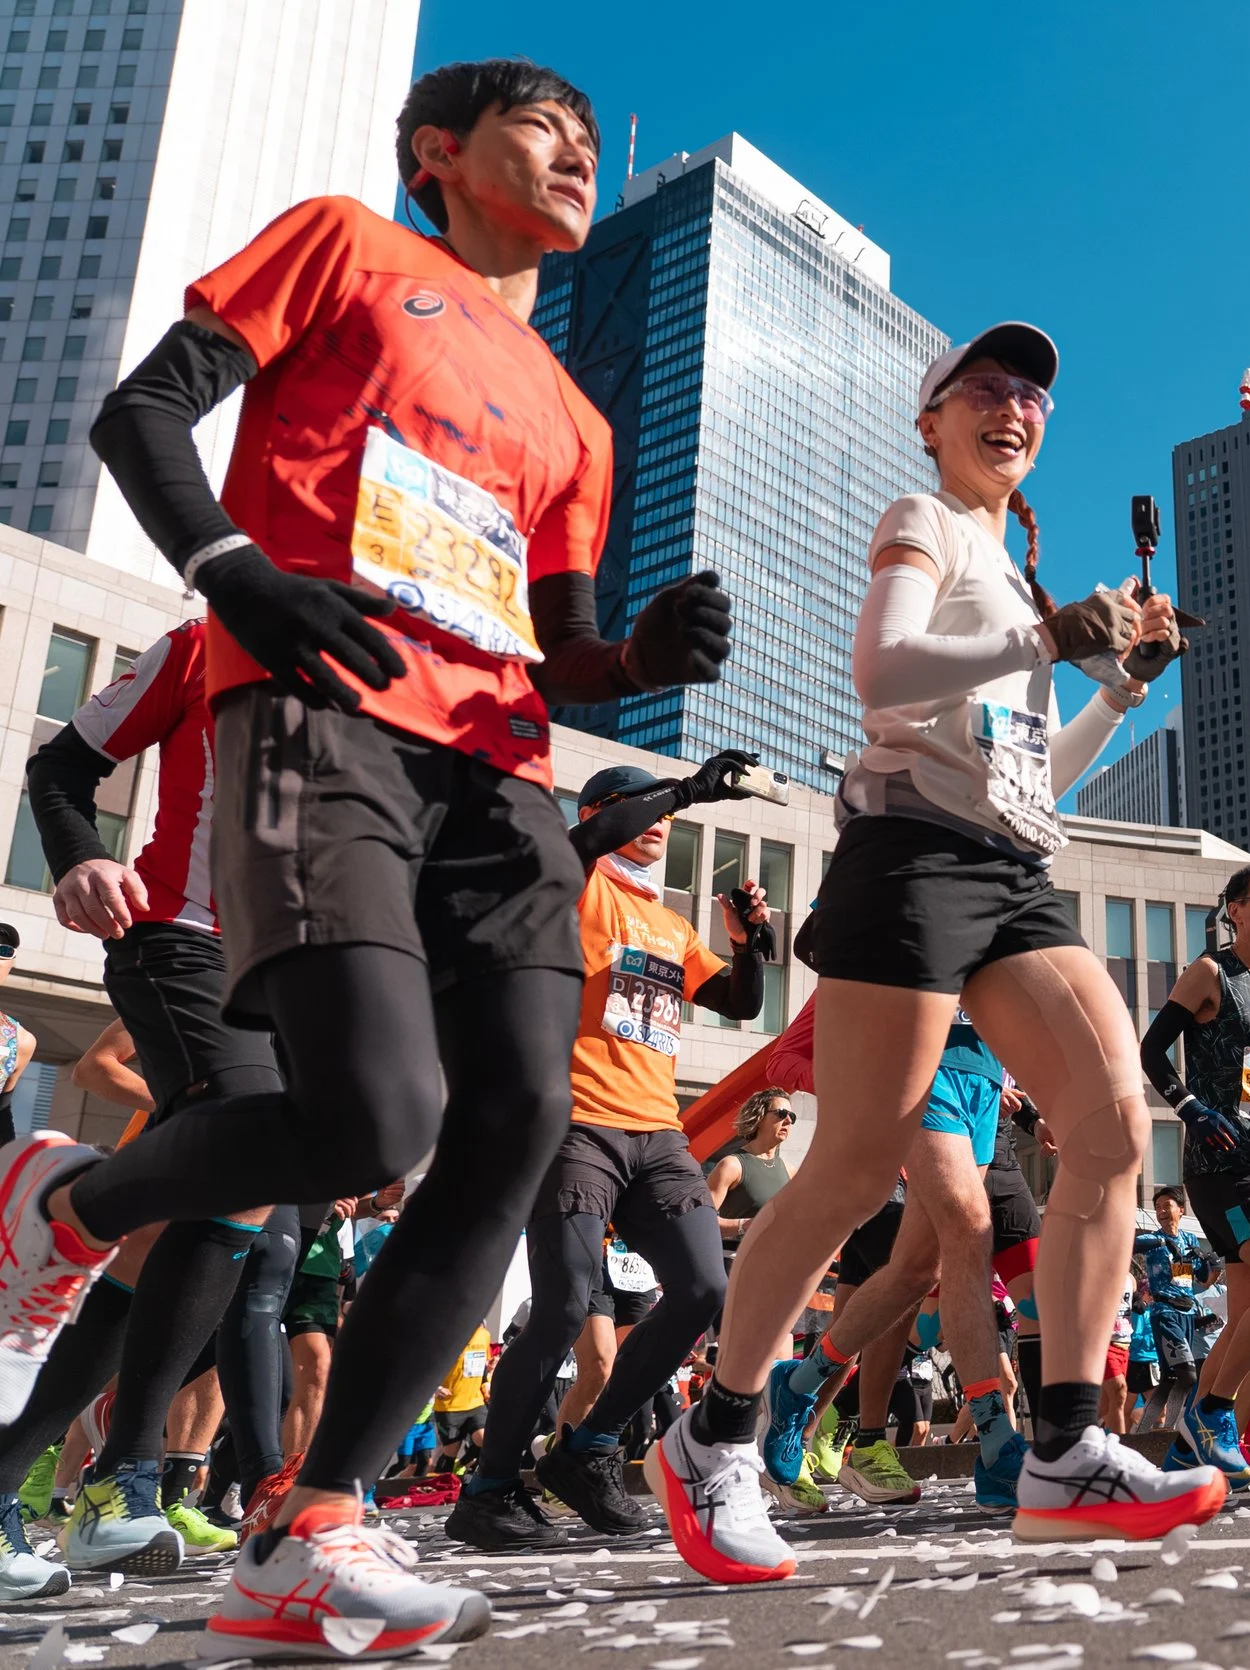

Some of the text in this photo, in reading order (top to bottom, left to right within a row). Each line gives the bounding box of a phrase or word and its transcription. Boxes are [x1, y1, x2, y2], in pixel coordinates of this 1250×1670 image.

[371, 494, 394, 523] E
[368, 543, 385, 565] 3
[409, 511, 518, 619] 23292
[613, 977, 625, 991] D
